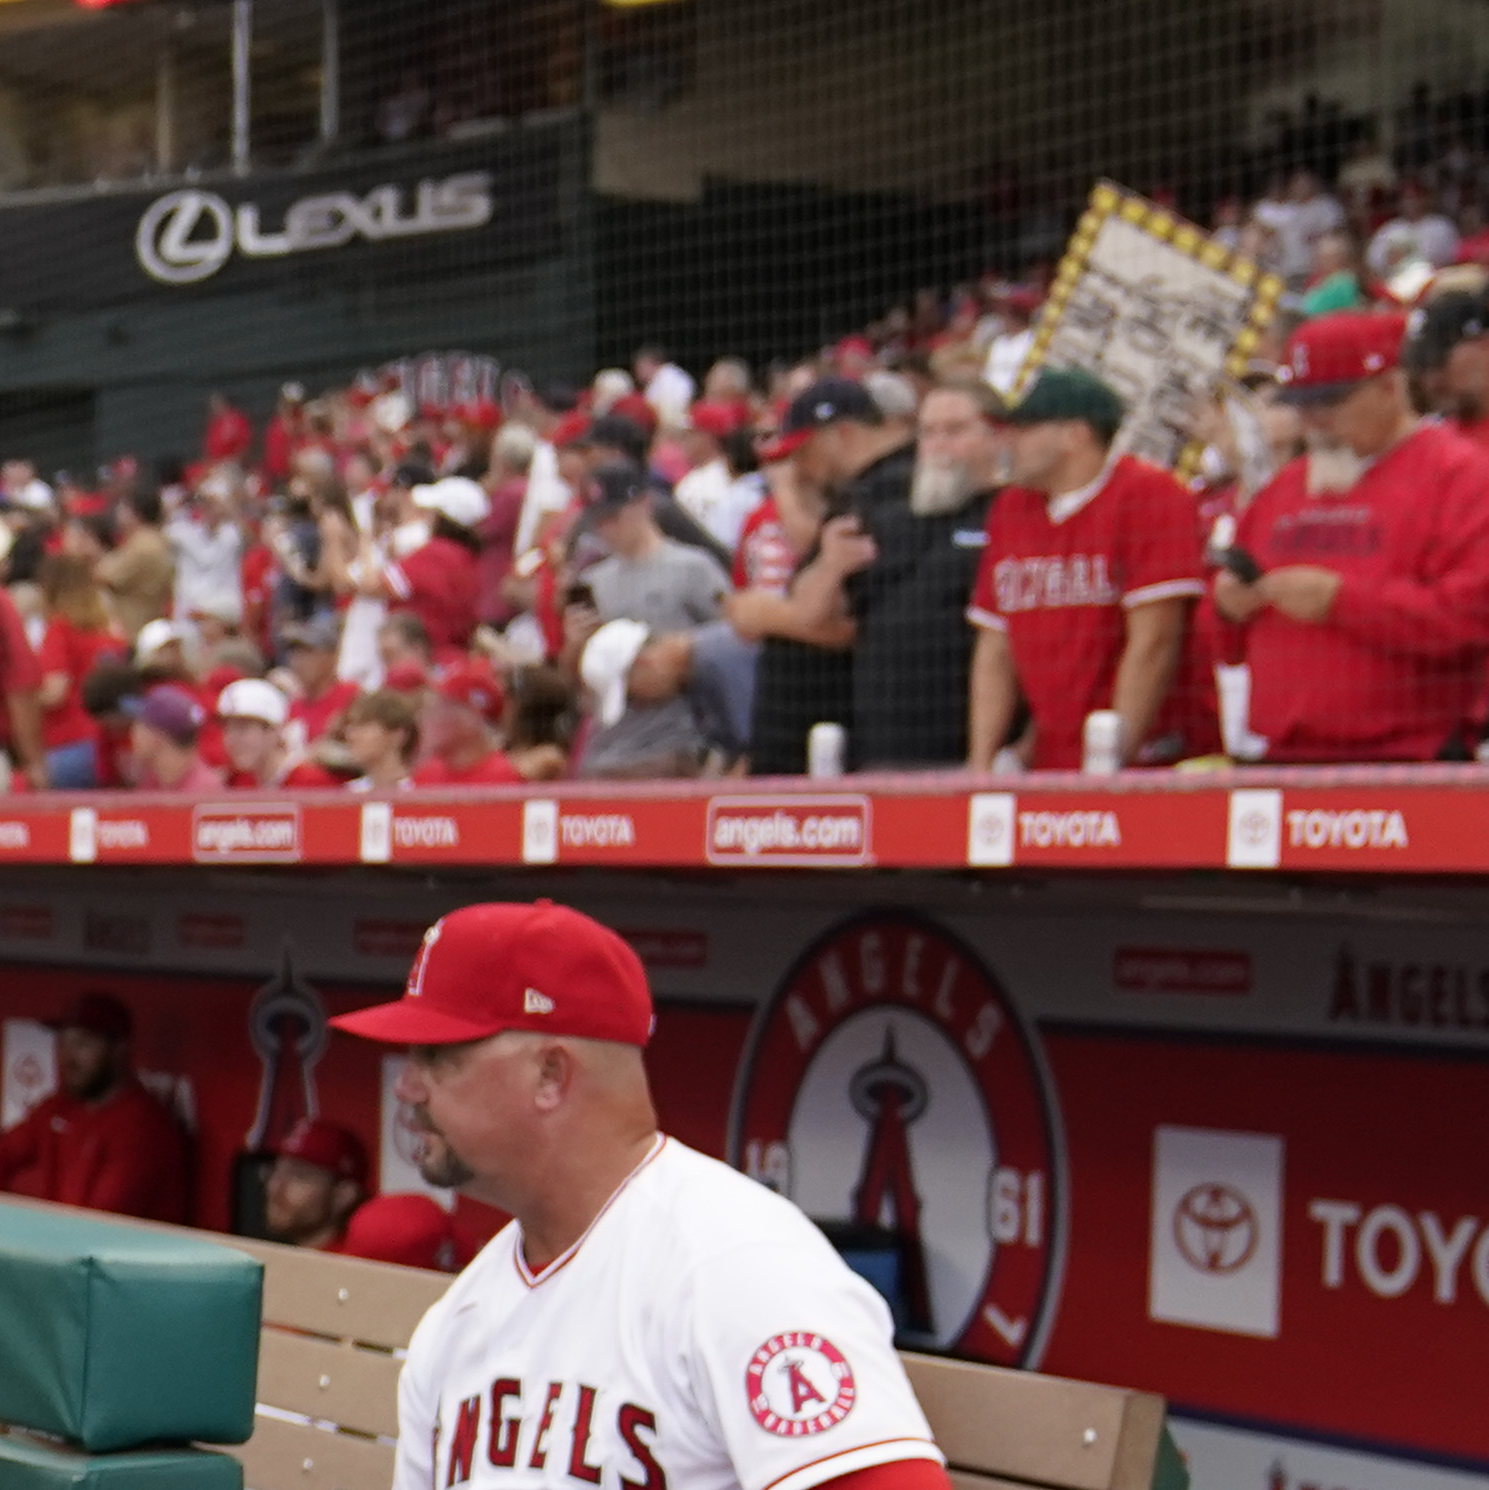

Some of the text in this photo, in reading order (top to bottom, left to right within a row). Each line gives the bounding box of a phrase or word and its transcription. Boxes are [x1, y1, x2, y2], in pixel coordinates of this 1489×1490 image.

[240, 171, 495, 257] LEXUS
[393, 816, 459, 847] TOYOTA
[560, 814, 636, 847] TOYOTA
[713, 806, 861, 857] angels.com
[1018, 810, 1122, 848] TOYOTA
[1286, 809, 1409, 851] TOYOTA
[786, 931, 1004, 1060] ANGELS
[991, 1166, 1045, 1249] 61
[1307, 1197, 1489, 1304] TOY
